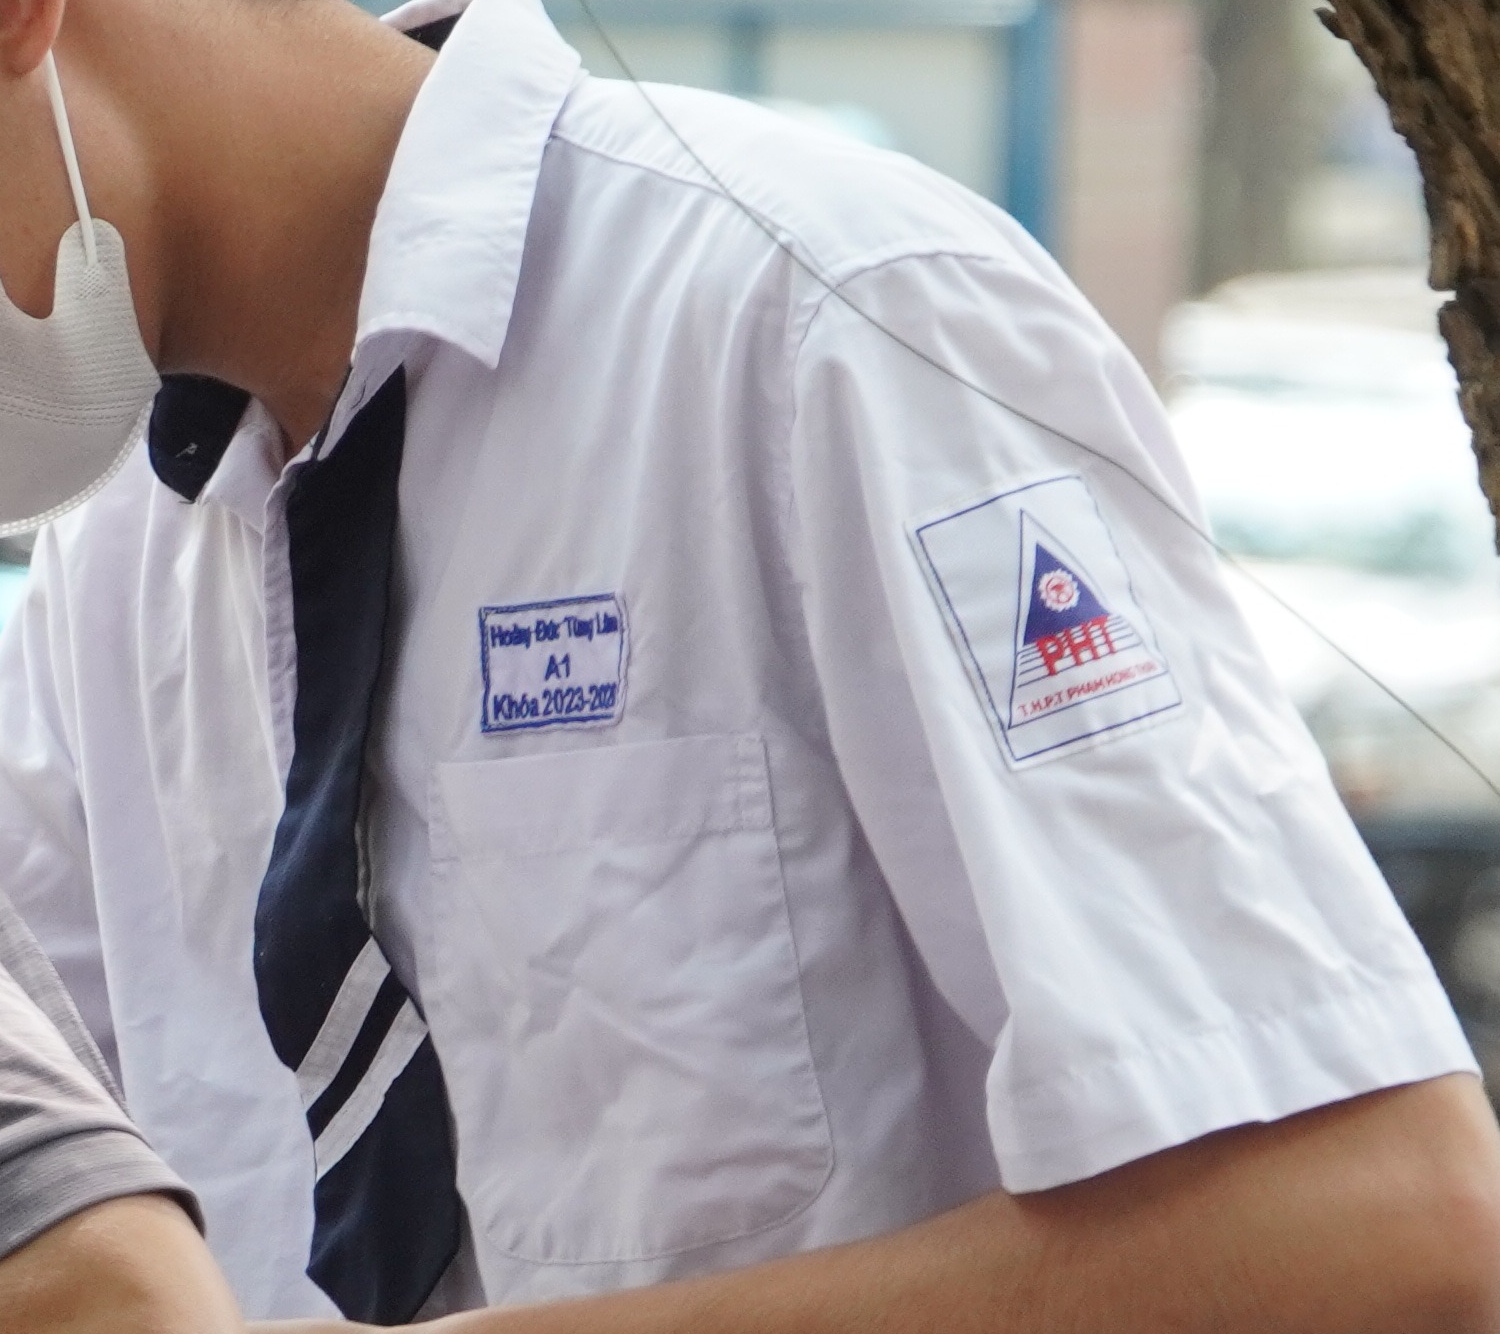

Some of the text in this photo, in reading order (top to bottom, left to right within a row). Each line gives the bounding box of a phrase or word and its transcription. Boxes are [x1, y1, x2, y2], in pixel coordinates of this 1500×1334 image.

[1035, 614, 1117, 676] PHT
[543, 652, 571, 681] A1
[492, 692, 540, 720] Khóa
